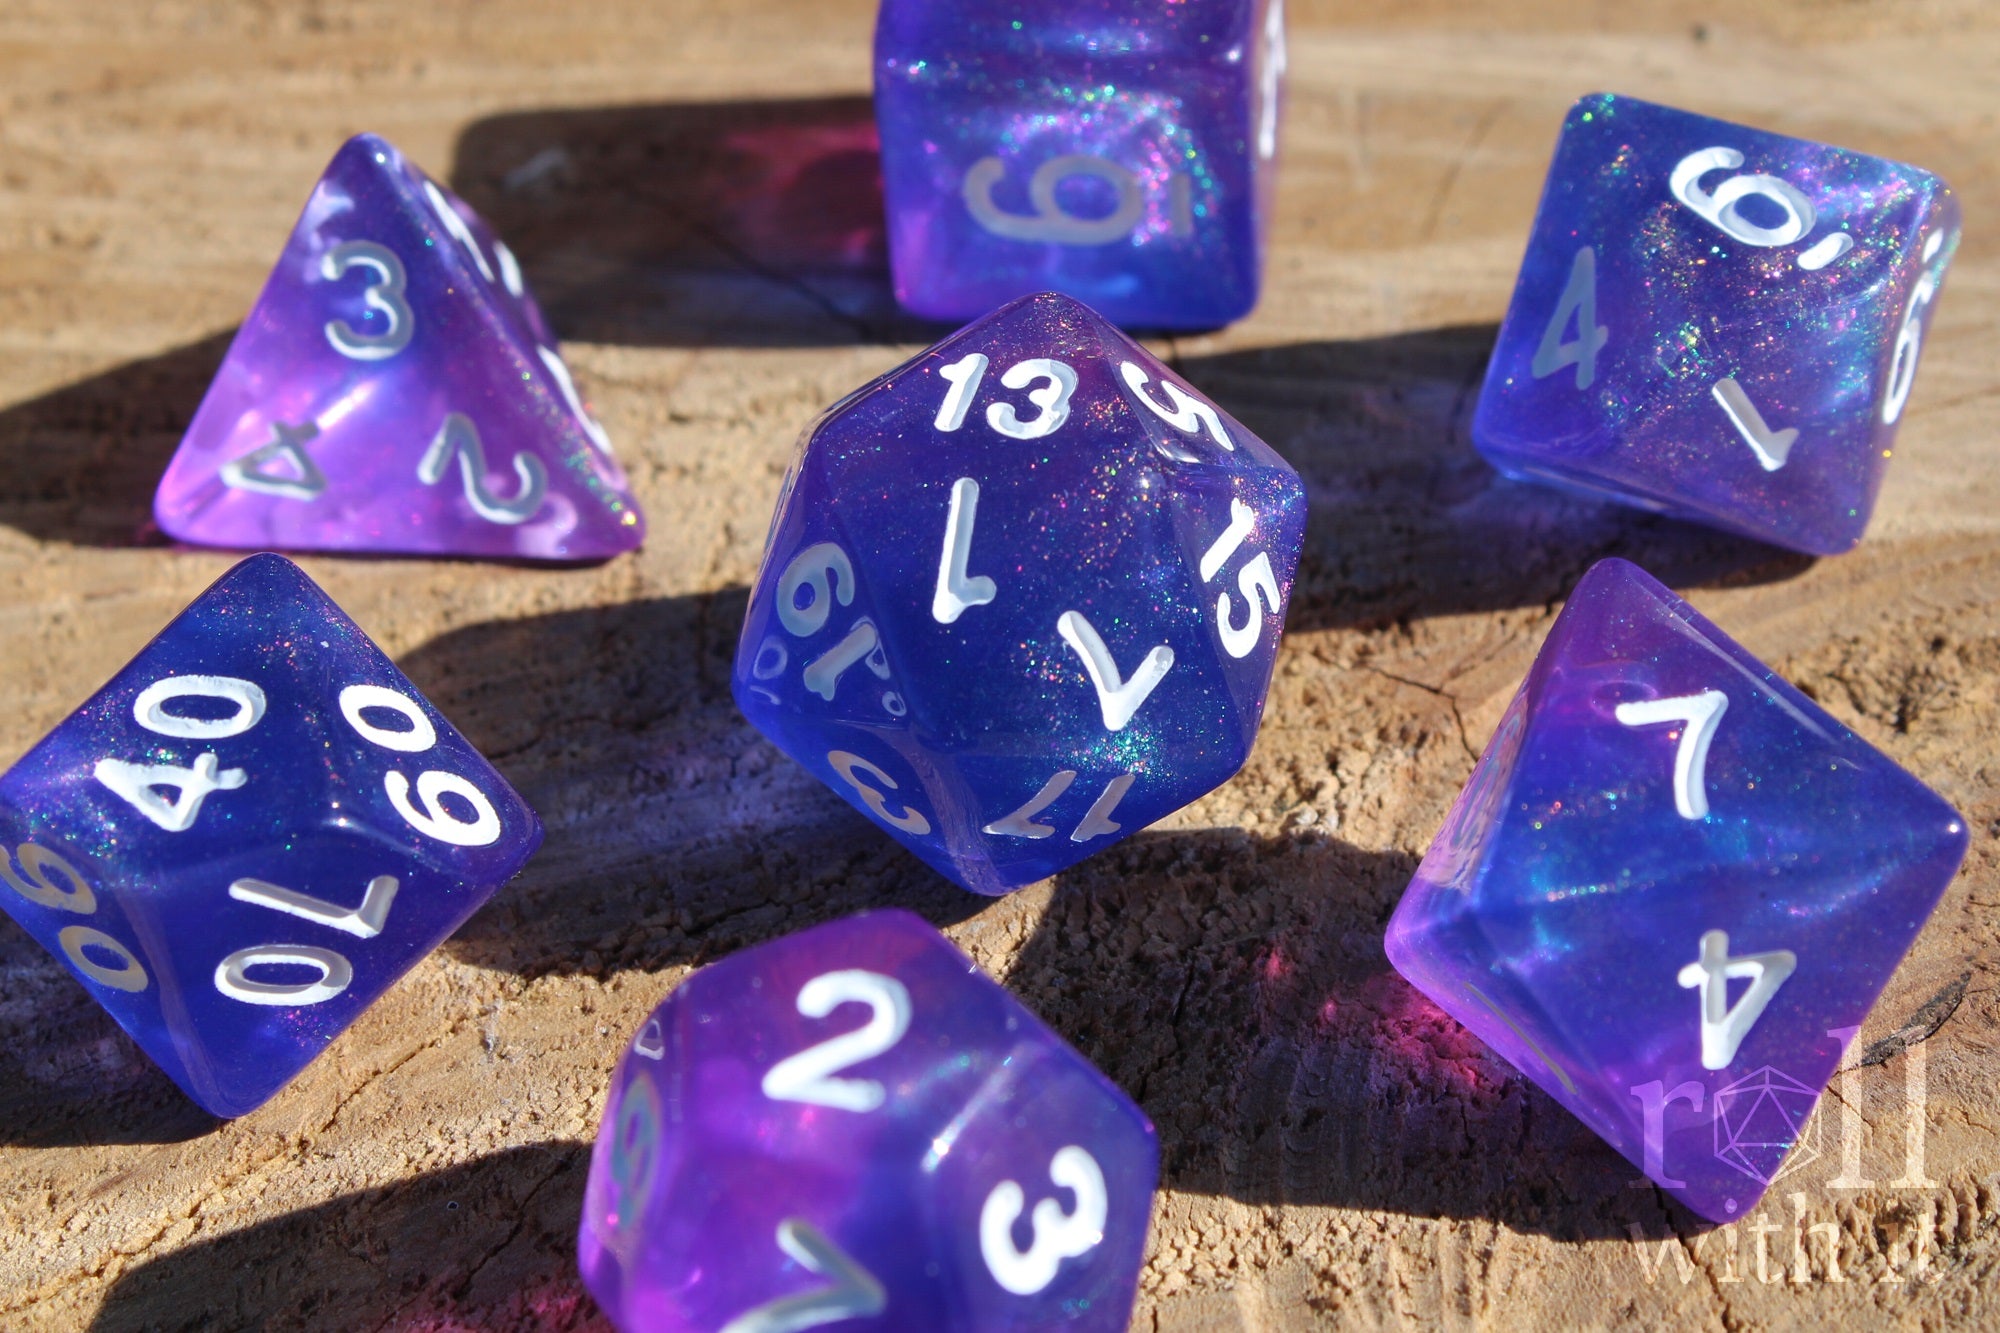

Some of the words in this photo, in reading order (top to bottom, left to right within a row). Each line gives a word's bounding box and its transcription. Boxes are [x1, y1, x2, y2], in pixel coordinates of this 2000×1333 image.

[1670, 146, 1816, 248] 6
[322, 240, 413, 360] 3
[1532, 246, 1608, 390] 4
[934, 353, 1078, 439] 13
[1120, 361, 1234, 451] 5
[219, 421, 326, 501] 4
[418, 413, 547, 524] 2
[1199, 498, 1280, 658] 15
[1057, 610, 1175, 731] 7
[94, 674, 267, 832] 40
[827, 750, 931, 835] 3
[1615, 690, 1729, 820] 7
[762, 969, 911, 1113] 2
[1677, 929, 1797, 1070] 4
[980, 1144, 1108, 1296] 3
